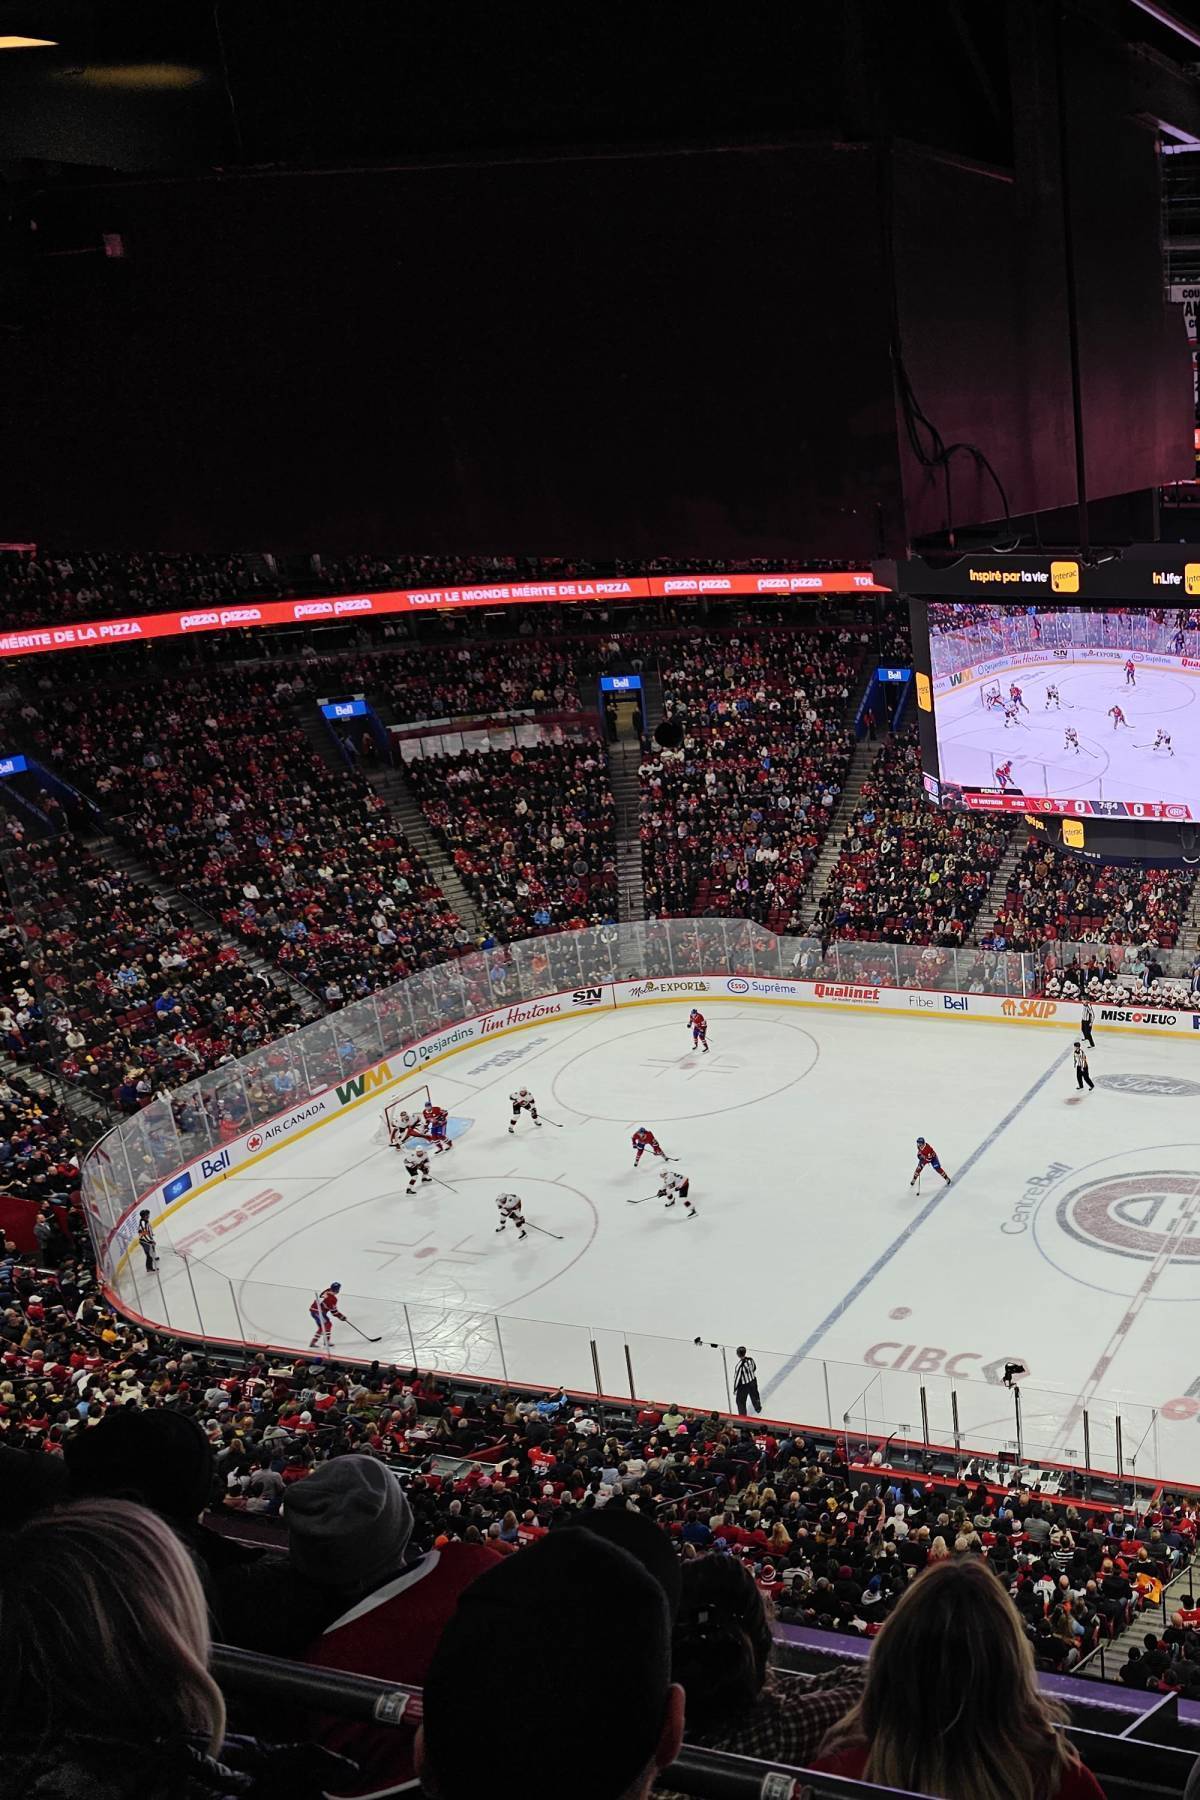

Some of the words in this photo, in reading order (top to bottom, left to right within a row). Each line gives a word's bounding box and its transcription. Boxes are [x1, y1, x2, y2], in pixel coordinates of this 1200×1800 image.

[664, 580, 698, 594] pizza
[698, 579, 732, 593] pizza
[757, 579, 790, 592] pizza
[790, 577, 823, 591] pizza
[1002, 572, 1021, 584] par
[1152, 571, 1182, 585] InLife
[407, 592, 442, 606] TOUT
[445, 591, 461, 603] LE
[462, 587, 510, 602] MONDE
[511, 582, 557, 600] MÉRITE
[559, 584, 576, 597] DE
[578, 583, 595, 596] LA
[596, 582, 632, 595] PIZZA
[294, 601, 333, 619] pizza
[334, 598, 373, 616] pizza
[180, 613, 220, 631] pizza
[220, 607, 262, 626] pizza
[54, 628, 76, 645] DE
[78, 625, 98, 641] LA
[100, 621, 143, 638] PIZZA
[613, 678, 629, 689] Bell
[887, 670, 903, 681] Bell
[949, 668, 974, 688] WM
[335, 705, 354, 717] Bell
[1075, 801, 1085, 814] 0
[1134, 803, 1144, 816] 0
[572, 987, 603, 1003] SN
[729, 981, 747, 990] Esso
[752, 981, 798, 995] Suprême
[814, 983, 881, 1000] Qualinet
[909, 995, 934, 1009] Fibe
[944, 995, 969, 1012] Bell
[1019, 999, 1058, 1019] SKIP
[478, 1015, 505, 1036] Tim
[506, 1003, 562, 1026] Hortons
[419, 1026, 474, 1058] Desjardins
[335, 1062, 394, 1106] WM
[1112, 1077, 1188, 1096] Ford
[264, 1125, 282, 1141] AIR
[282, 1102, 326, 1131] CANADA
[200, 1150, 231, 1180] Bell
[863, 1341, 984, 1379] CIBC
